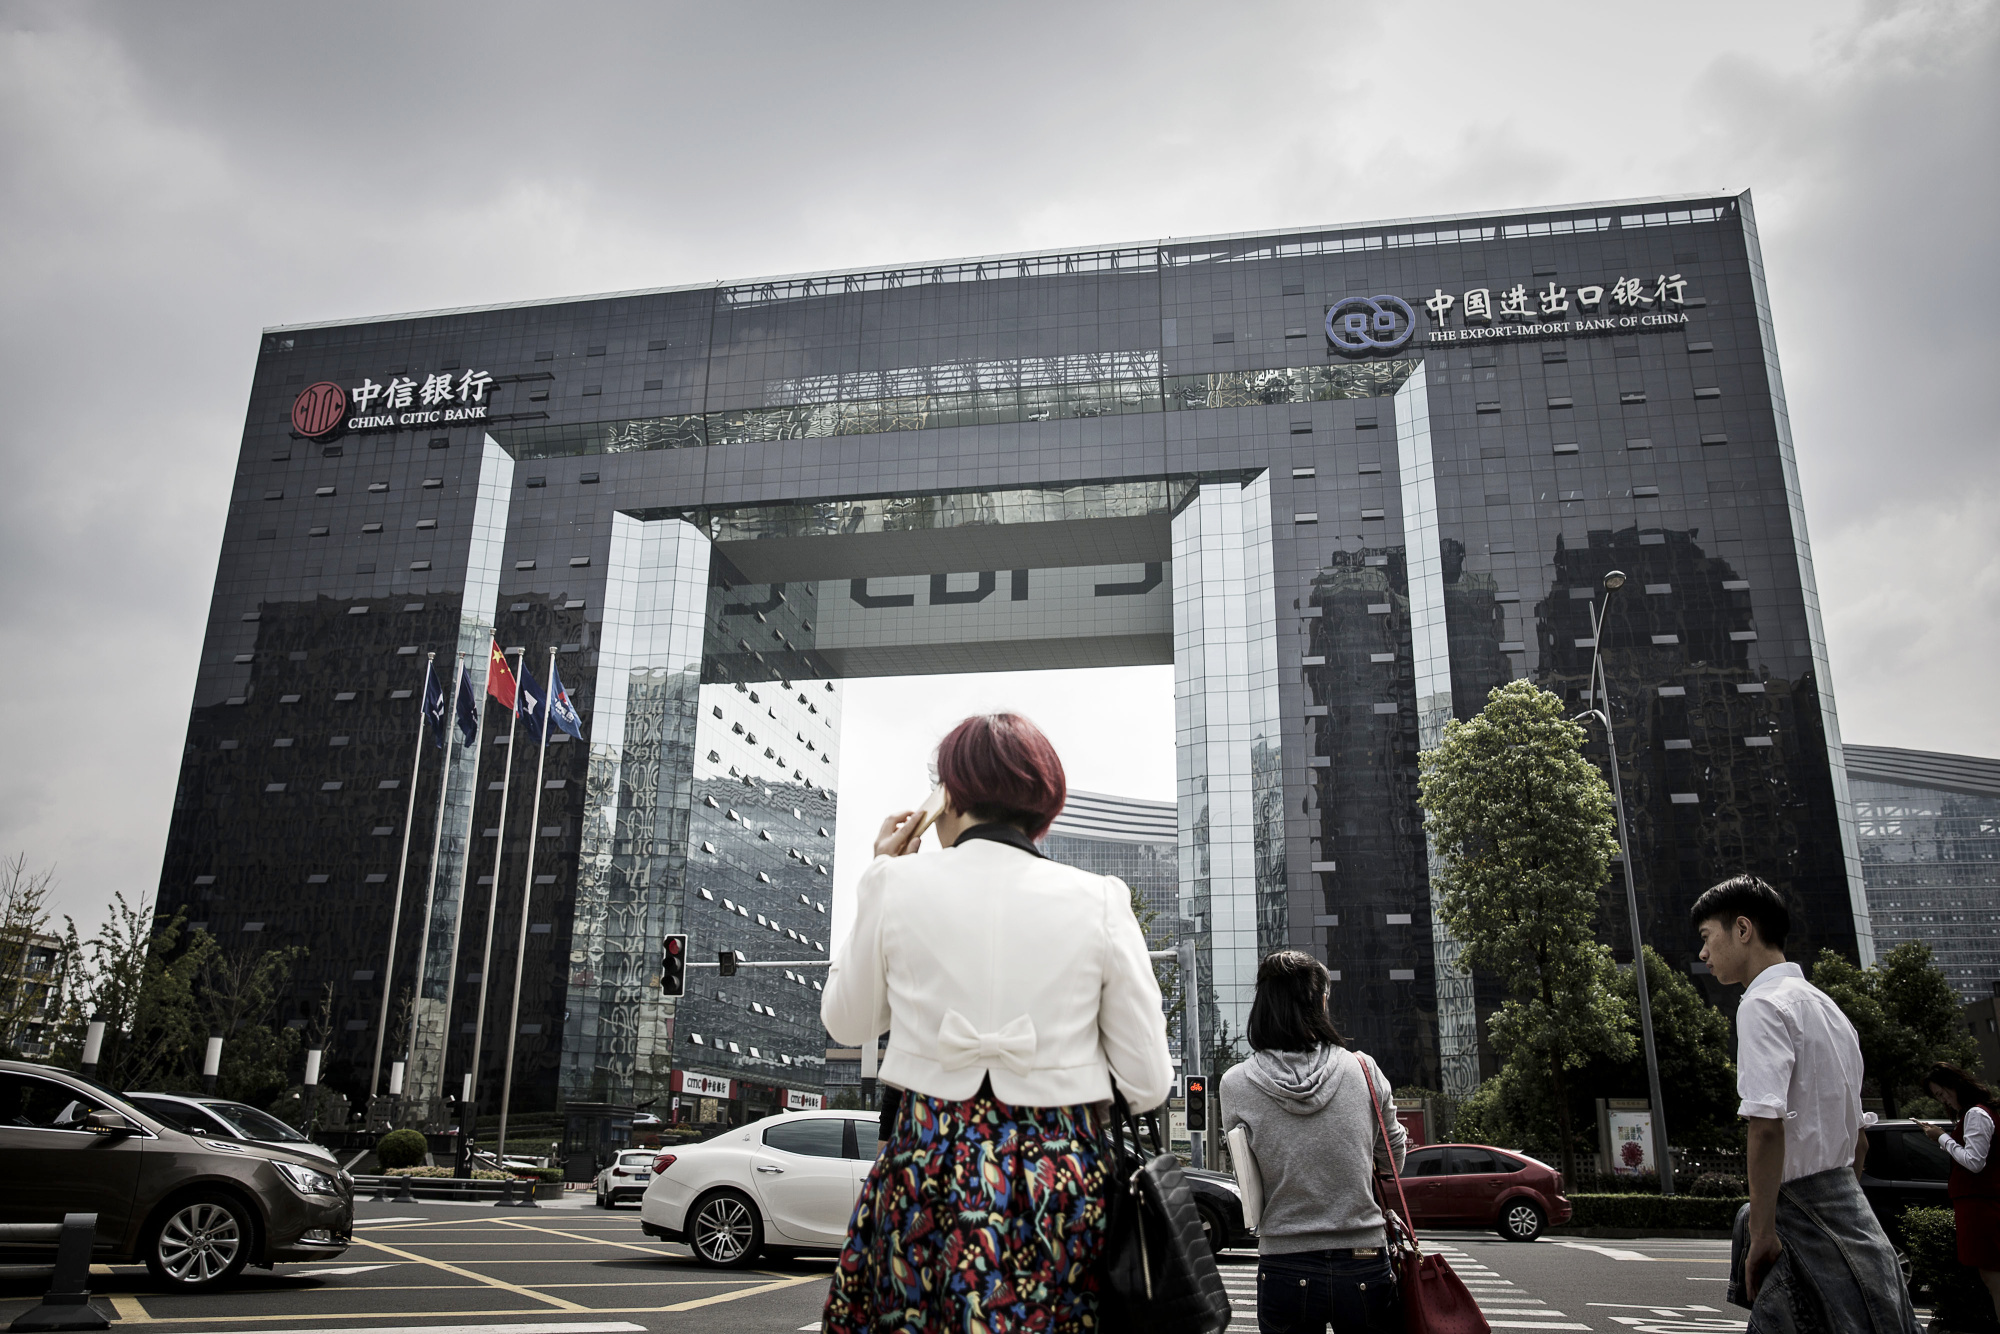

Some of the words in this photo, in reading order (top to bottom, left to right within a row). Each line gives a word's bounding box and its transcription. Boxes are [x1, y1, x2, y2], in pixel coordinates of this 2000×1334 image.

[1425, 273, 1688, 327] 中国进出口银行
[1429, 330, 1457, 342] THE
[1460, 321, 1571, 340] EXPORT-IMPORT
[1575, 318, 1616, 331] BANK
[1619, 316, 1638, 328] OF
[1641, 312, 1689, 326] CHINA
[352, 368, 494, 413] 中信银行
[348, 415, 395, 429] CHINA
[400, 410, 440, 425] CITIC
[444, 406, 487, 421] BANK
